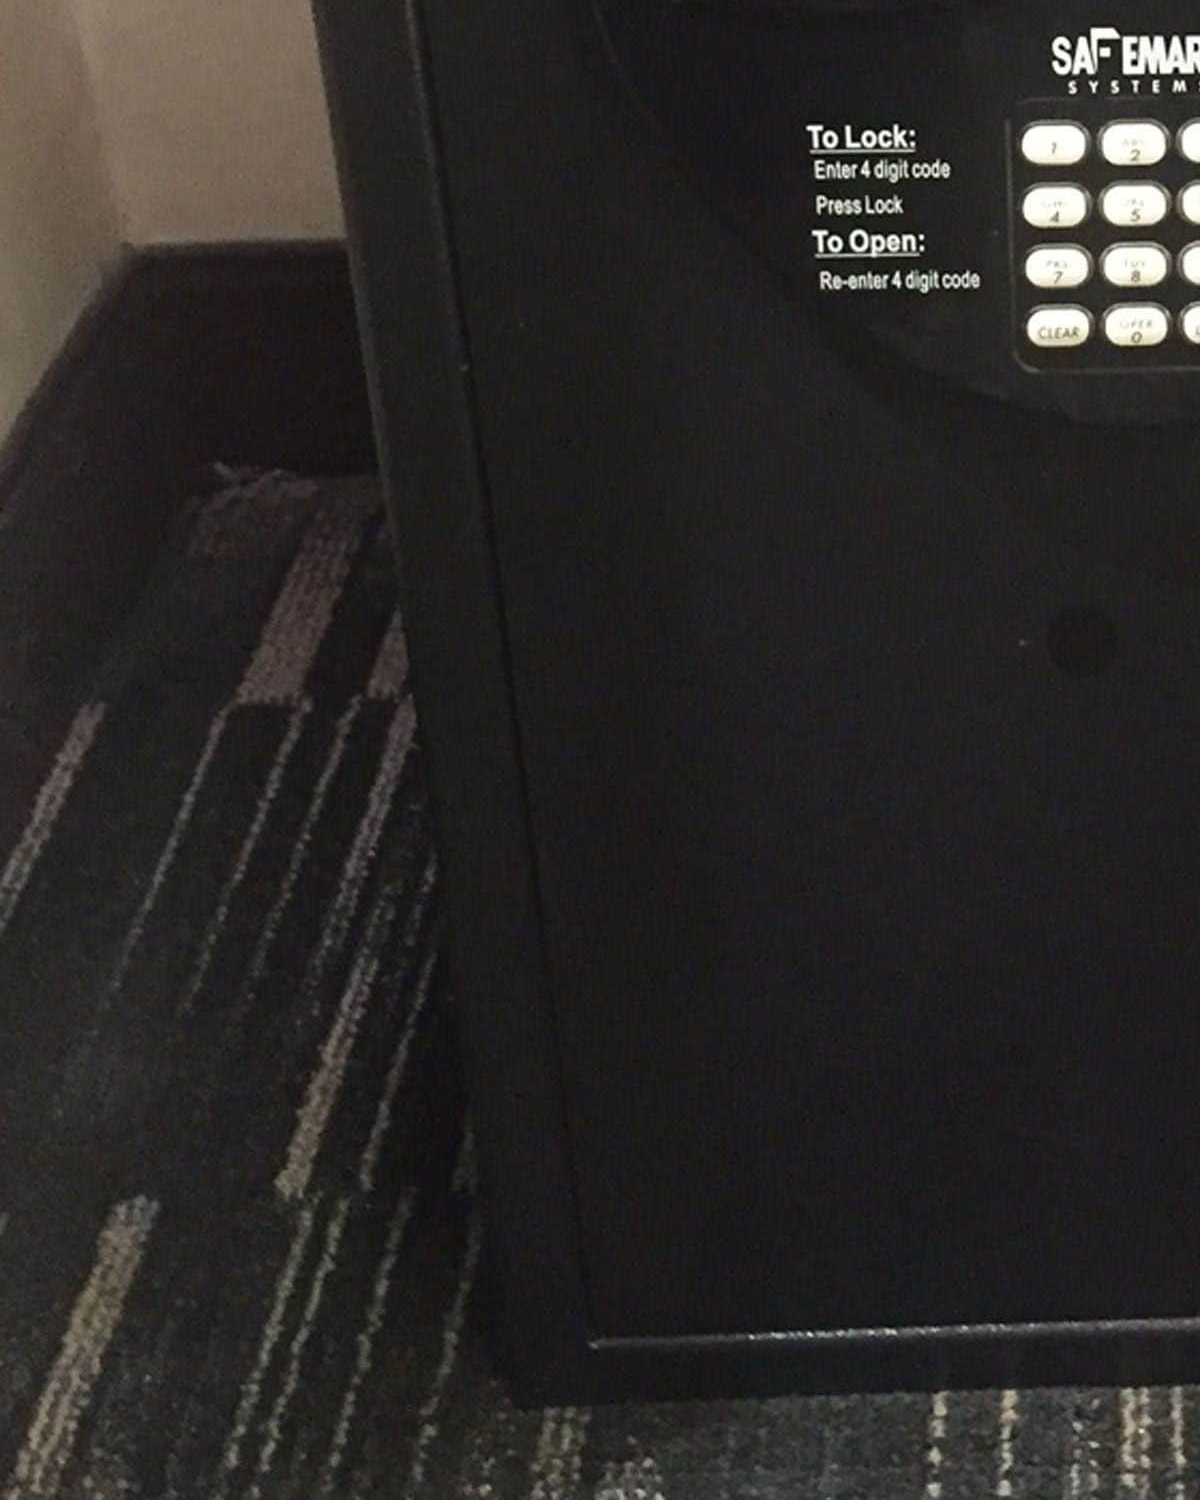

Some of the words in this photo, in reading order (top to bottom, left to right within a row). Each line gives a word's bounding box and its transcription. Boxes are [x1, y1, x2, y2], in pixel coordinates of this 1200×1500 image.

[806, 125, 839, 149] To
[844, 124, 916, 149] Lock:
[1130, 150, 1140, 162] 2
[814, 160, 858, 180] Enter
[860, 160, 870, 179] 4
[874, 159, 909, 183] digit
[912, 159, 950, 179] code
[816, 195, 862, 214] Press
[865, 194, 903, 214] Lock
[1050, 211, 1060, 223] 4
[1131, 210, 1141, 223] 5
[812, 229, 844, 253] To
[849, 229, 925, 258] Open:
[820, 270, 889, 290] Re-enter
[892, 271, 902, 290] 4
[905, 270, 939, 294] digit
[942, 270, 980, 289] code
[1053, 271, 1063, 284] 7
[1131, 269, 1141, 283] 8
[1037, 326, 1080, 340] CLEAR
